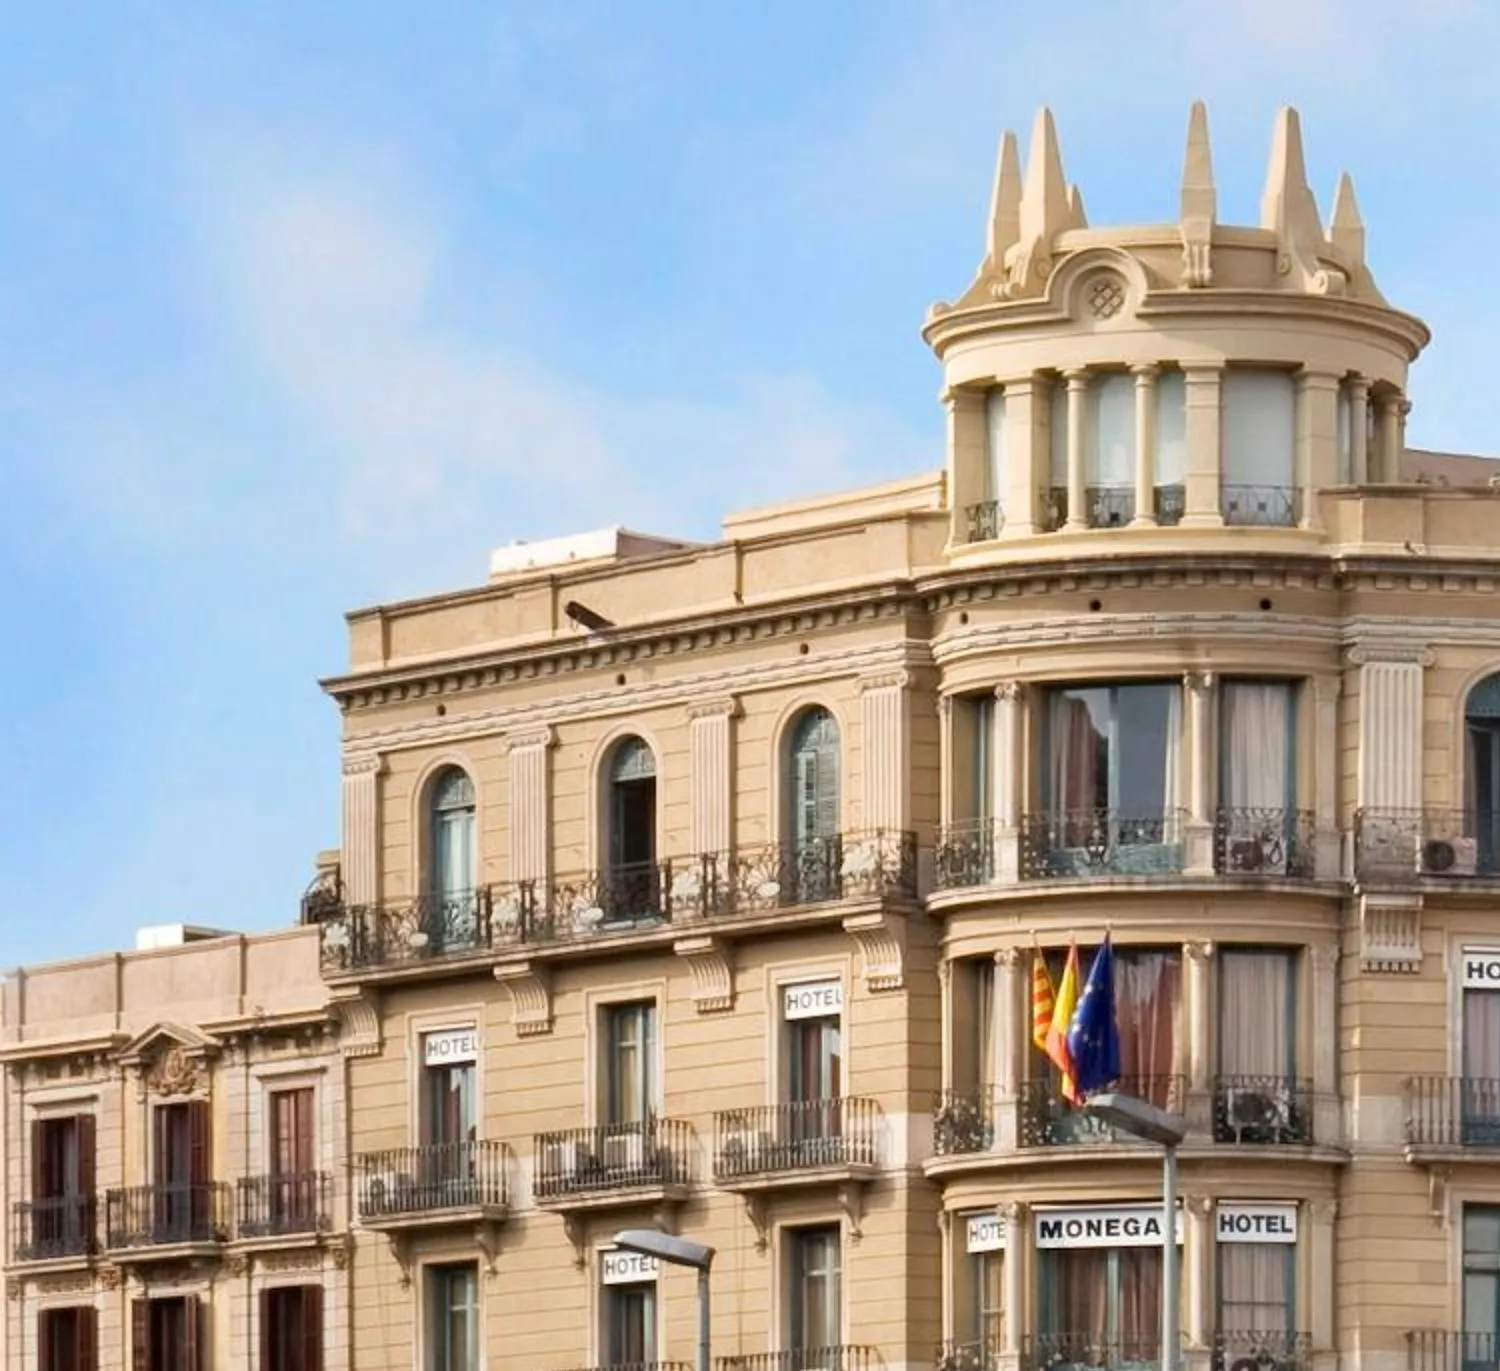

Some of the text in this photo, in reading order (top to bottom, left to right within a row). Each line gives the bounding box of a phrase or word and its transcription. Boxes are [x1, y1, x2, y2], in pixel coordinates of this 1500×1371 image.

[787, 988, 841, 1011] HOTEL
[427, 1037, 477, 1057] HOTEL
[969, 1221, 1007, 1244] HOTE
[1040, 1217, 1178, 1239] MONEGA
[1220, 1214, 1293, 1234] HOTEL
[605, 1257, 658, 1275] HOTEL
